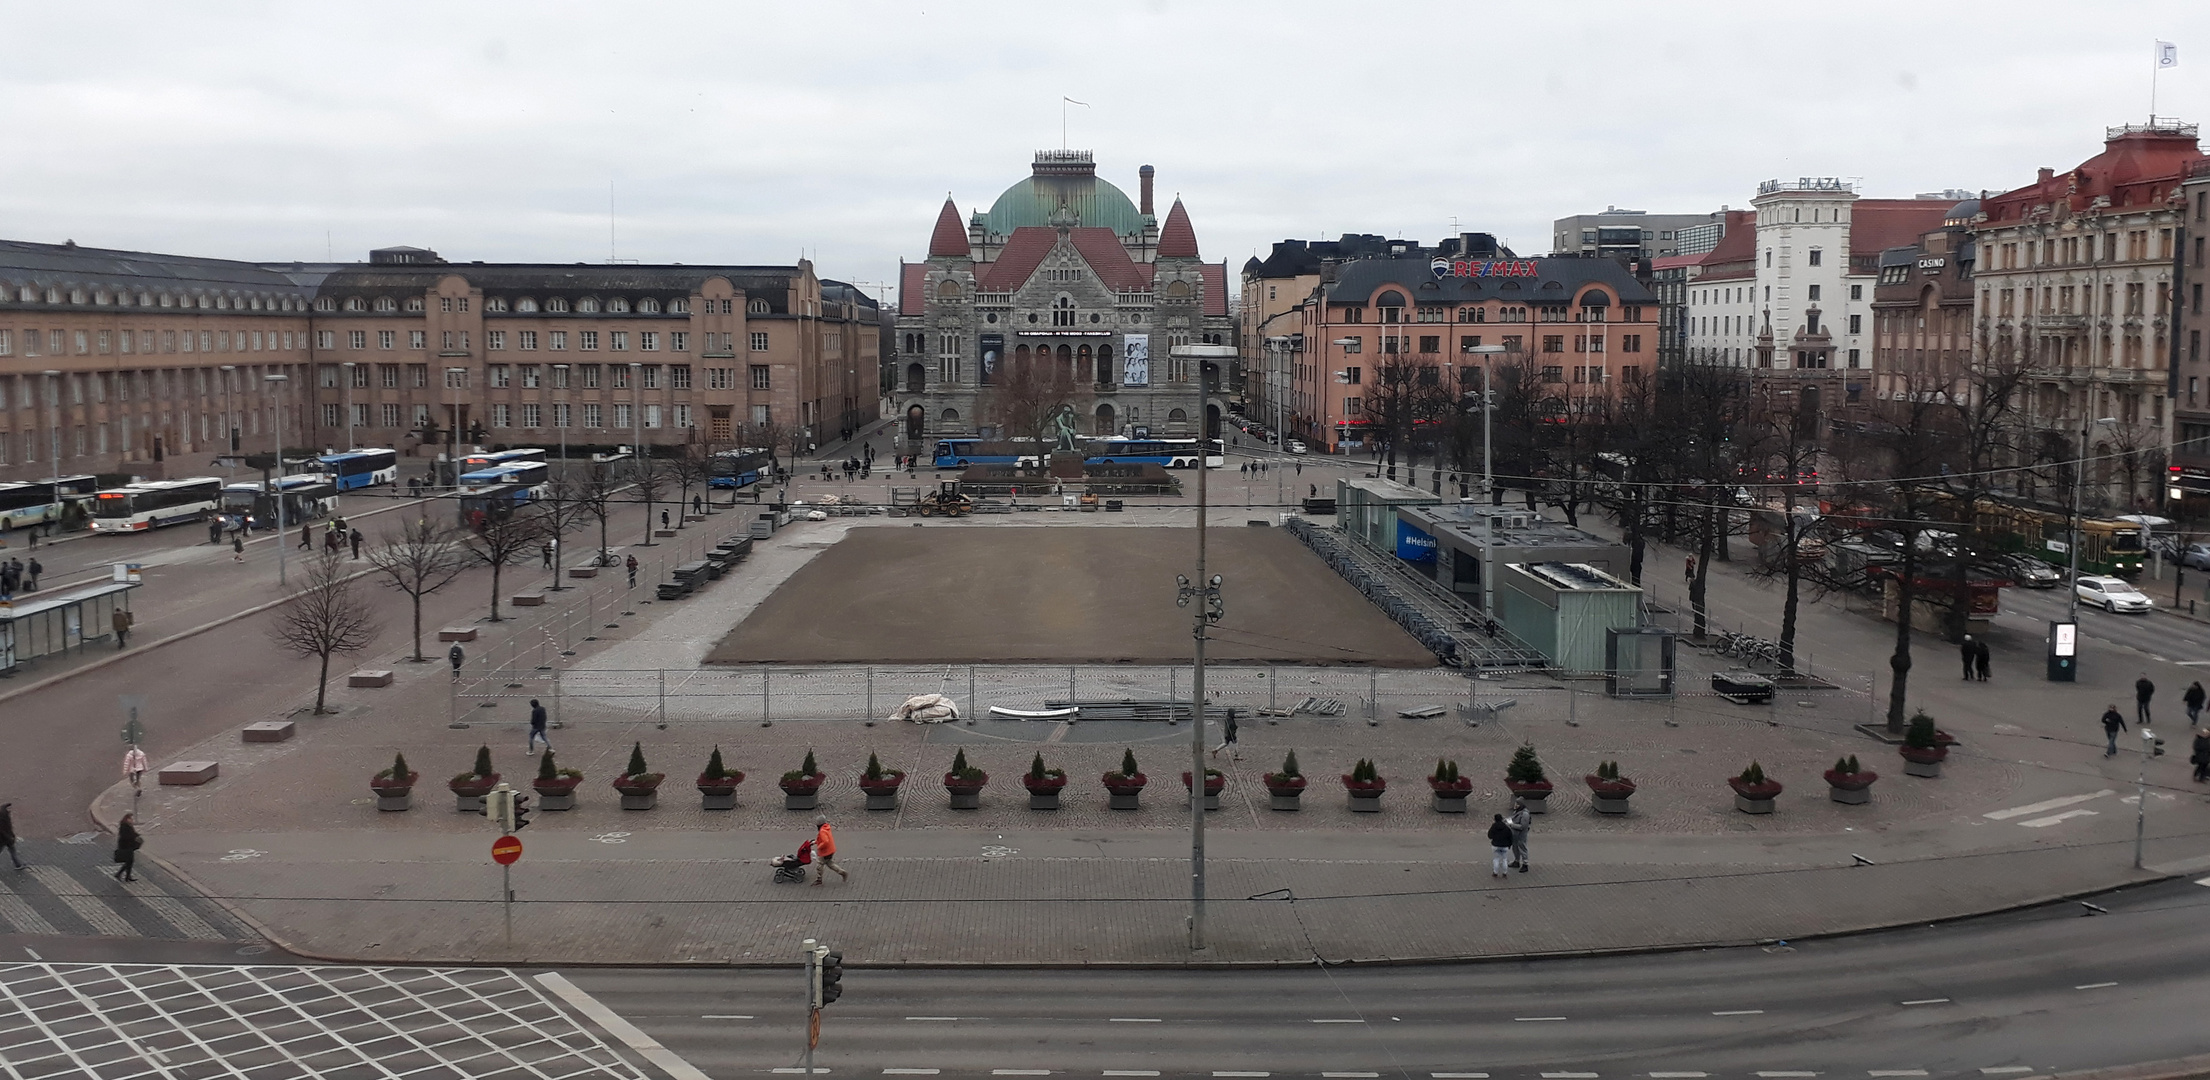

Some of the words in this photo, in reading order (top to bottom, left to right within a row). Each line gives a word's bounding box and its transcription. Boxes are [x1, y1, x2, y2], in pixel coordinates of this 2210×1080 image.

[1798, 177, 1842, 190] PLAZA
[1454, 260, 1538, 277] RE/MAX
[1918, 258, 1945, 268] CASINO
